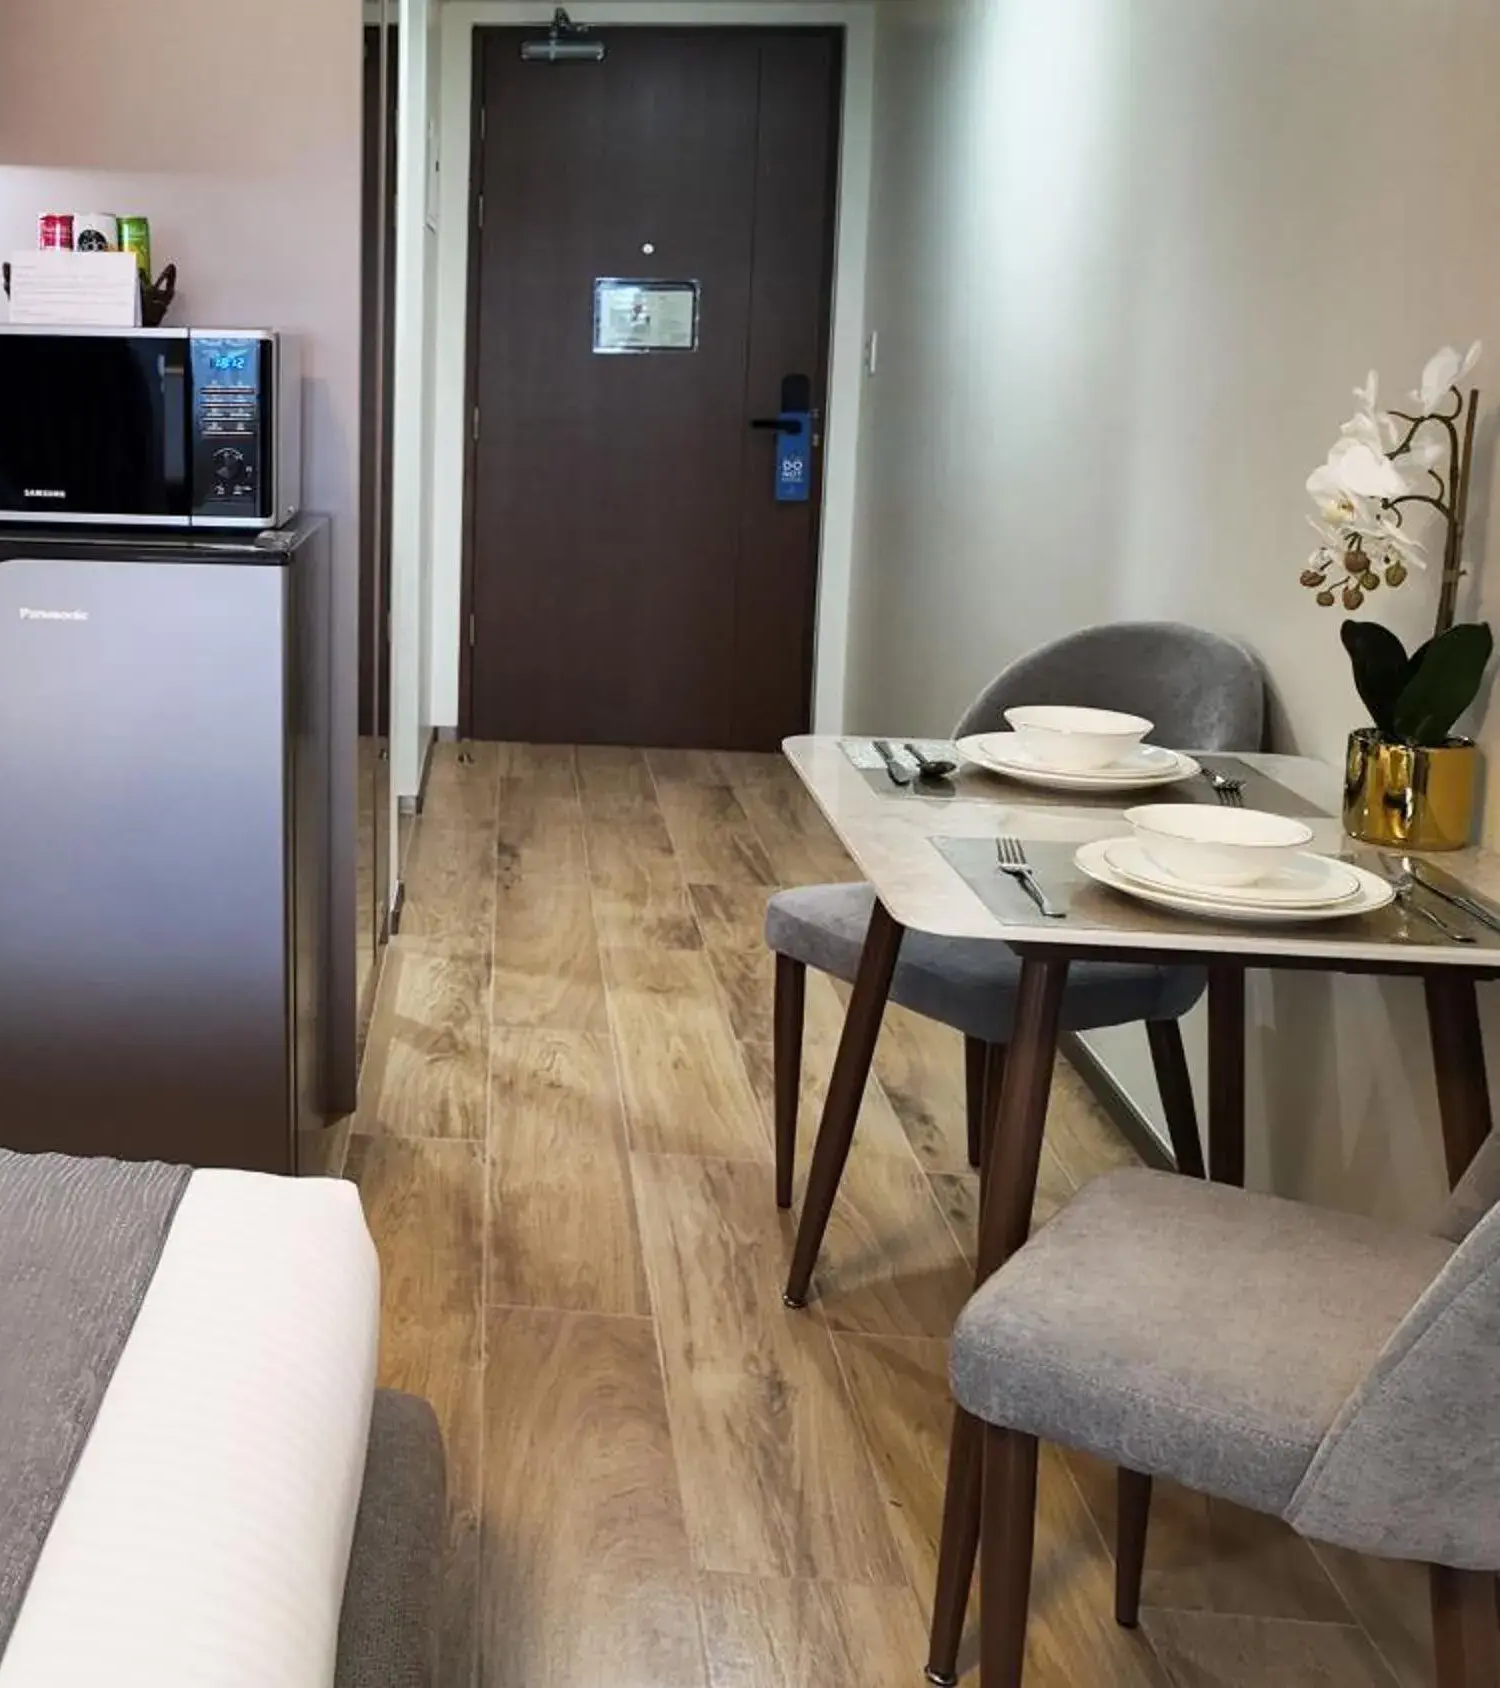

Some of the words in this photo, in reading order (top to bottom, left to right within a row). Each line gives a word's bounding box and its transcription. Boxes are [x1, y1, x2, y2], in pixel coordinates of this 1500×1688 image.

[783, 460, 803, 471] DO
[23, 489, 66, 498] SAMSUNG
[19, 607, 89, 621] Panasonic
